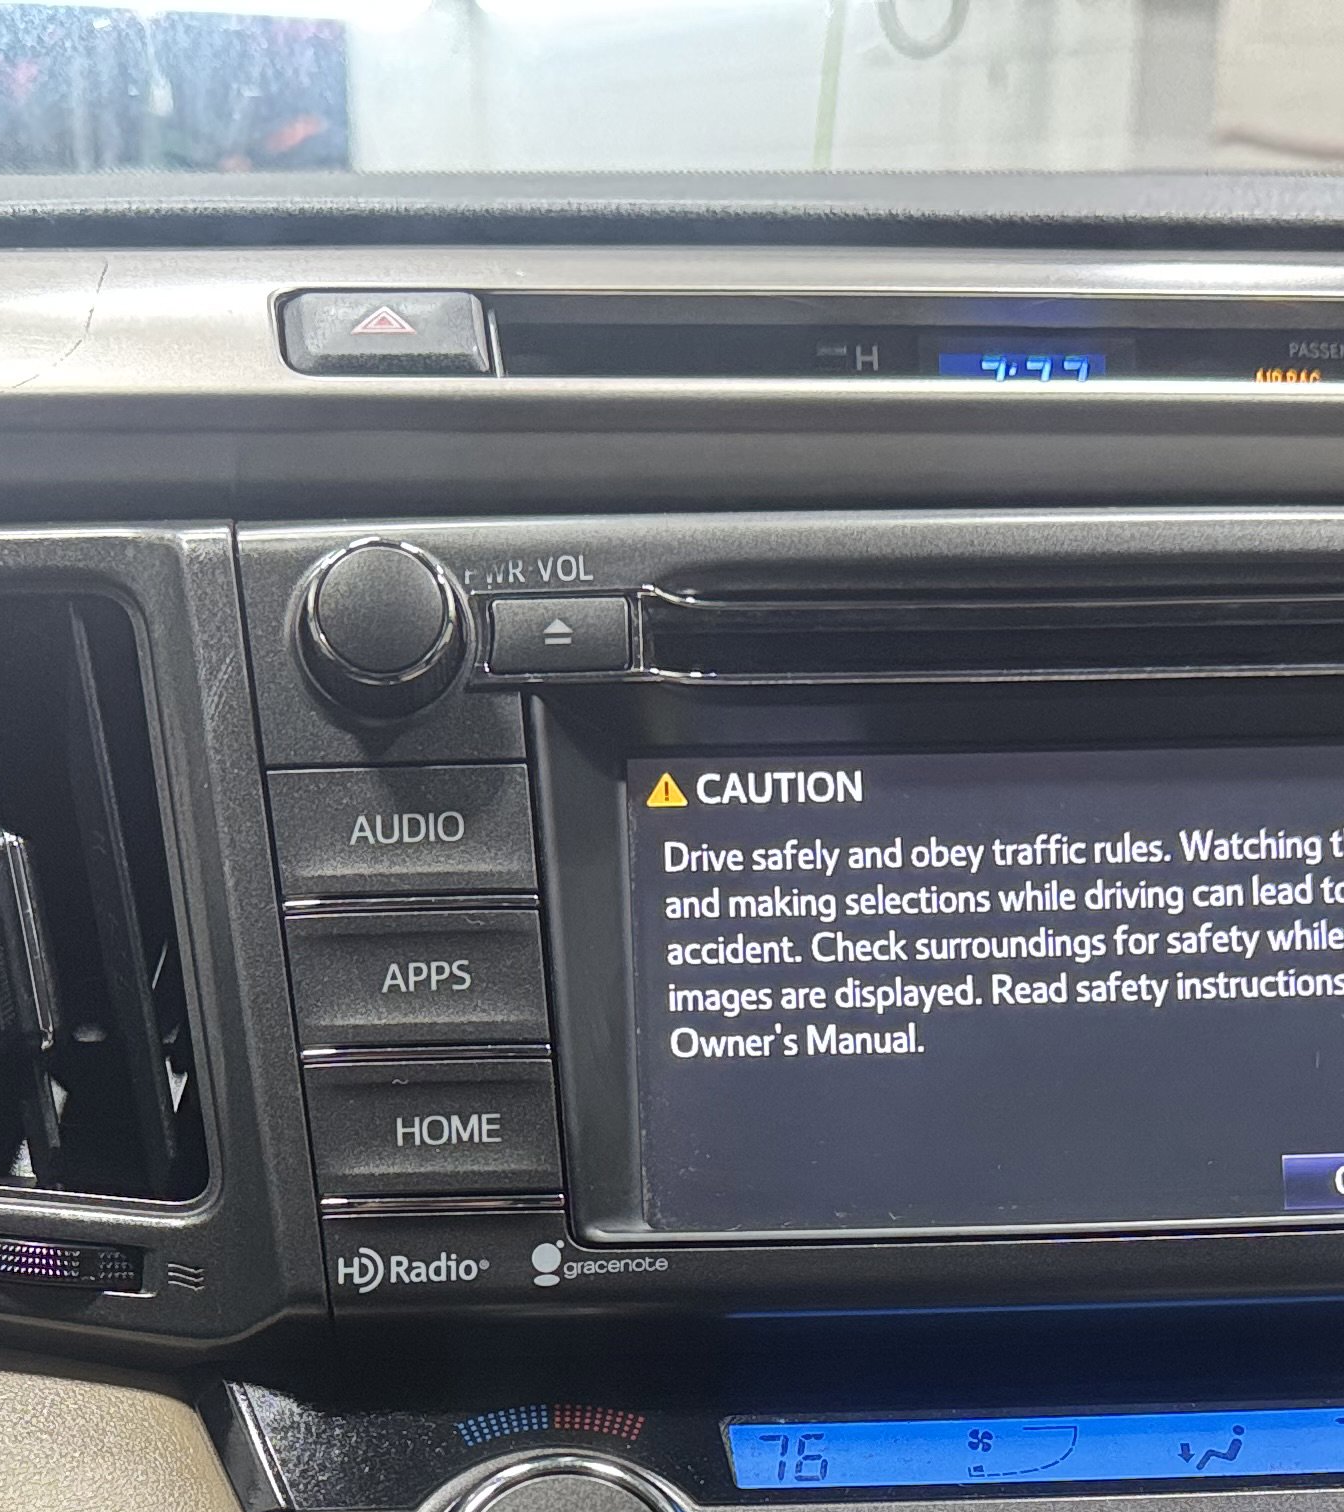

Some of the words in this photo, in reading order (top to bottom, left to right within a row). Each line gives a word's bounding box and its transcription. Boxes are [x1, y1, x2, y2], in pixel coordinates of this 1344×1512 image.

[855, 344, 880, 372] H
[696, 769, 863, 805] CAUTION
[349, 811, 466, 846] AUDIO
[664, 841, 744, 873] Drive
[751, 838, 841, 877] safely
[847, 836, 903, 869] and
[910, 835, 985, 874] obey
[991, 832, 1087, 866] traffic
[1093, 831, 1172, 864] rules.
[1178, 827, 1323, 866] Watching
[665, 886, 721, 919] and
[728, 885, 837, 923] making
[844, 883, 992, 916] selections
[997, 879, 1077, 912] while
[1084, 878, 1184, 915] driving
[1192, 883, 1245, 908] can
[1251, 872, 1314, 906] lead
[666, 932, 803, 966] accident.
[811, 929, 909, 963] Check
[914, 926, 1107, 964] surroundings
[1112, 923, 1161, 956] for
[1166, 921, 1261, 959] safety
[380, 959, 473, 993] APPS
[668, 983, 773, 1018] images
[780, 986, 827, 1010] are
[834, 974, 983, 1015] displayed.
[991, 971, 1069, 1005] Read
[1075, 970, 1170, 1008] safety
[670, 1022, 799, 1059] Owner's
[806, 1021, 925, 1056] Manual.
[395, 1112, 503, 1147] HOME
[562, 1253, 670, 1280] gracenote
[758, 1432, 829, 1483] 76
